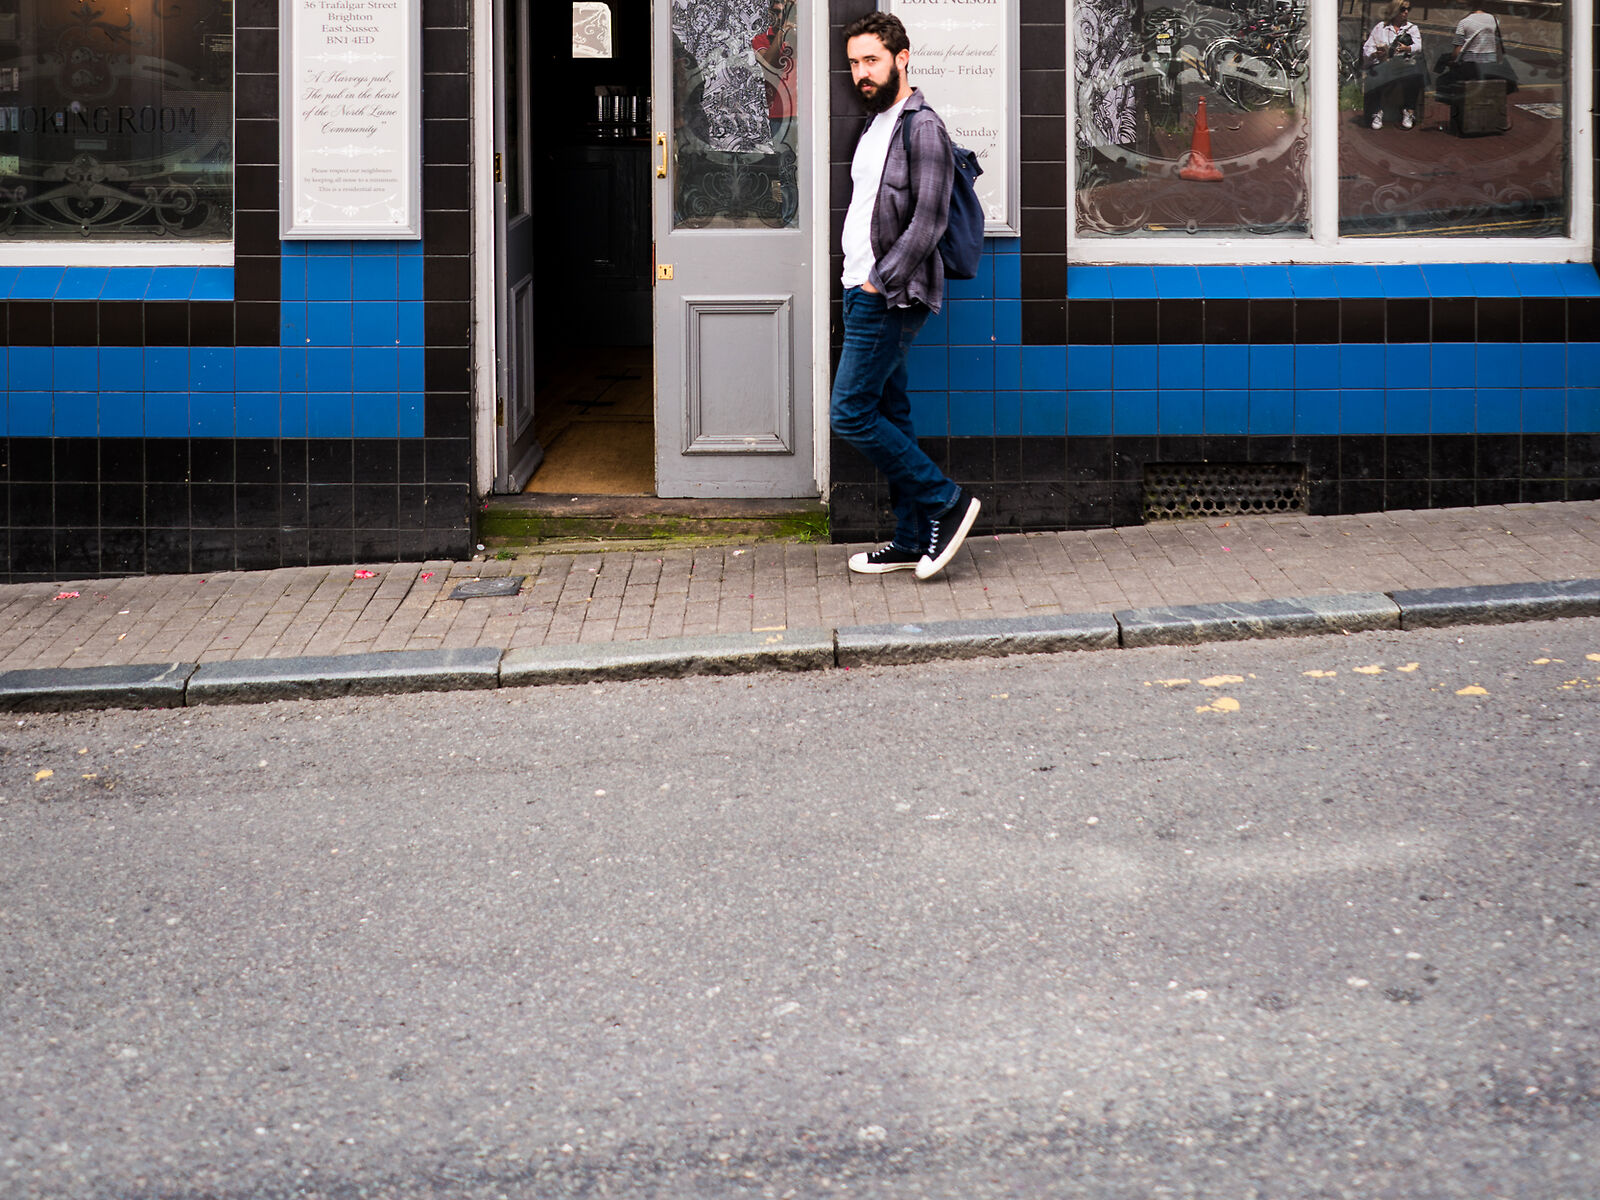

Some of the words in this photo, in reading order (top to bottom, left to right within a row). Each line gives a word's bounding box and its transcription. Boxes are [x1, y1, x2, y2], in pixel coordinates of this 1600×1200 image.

[304, 1, 316, 9] 36
[319, 1, 365, 11] Trafalgar
[367, 1, 397, 9] Street
[328, 13, 373, 22] Brighton
[322, 24, 343, 32] East
[345, 24, 379, 32] Sussex
[326, 36, 348, 44] BN1
[351, 36, 375, 44] 4ED
[942, 44, 969, 62] food
[958, 65, 995, 77] Friday
[326, 70, 369, 87] Harveys
[303, 87, 321, 100] The
[321, 88, 346, 104] pub
[357, 88, 371, 99] the
[374, 88, 400, 99] heart
[302, 106, 316, 120] of
[314, 105, 328, 116] the
[331, 104, 367, 117] North
[117, 106, 197, 134] ROOM
[955, 127, 998, 139] Sunday
